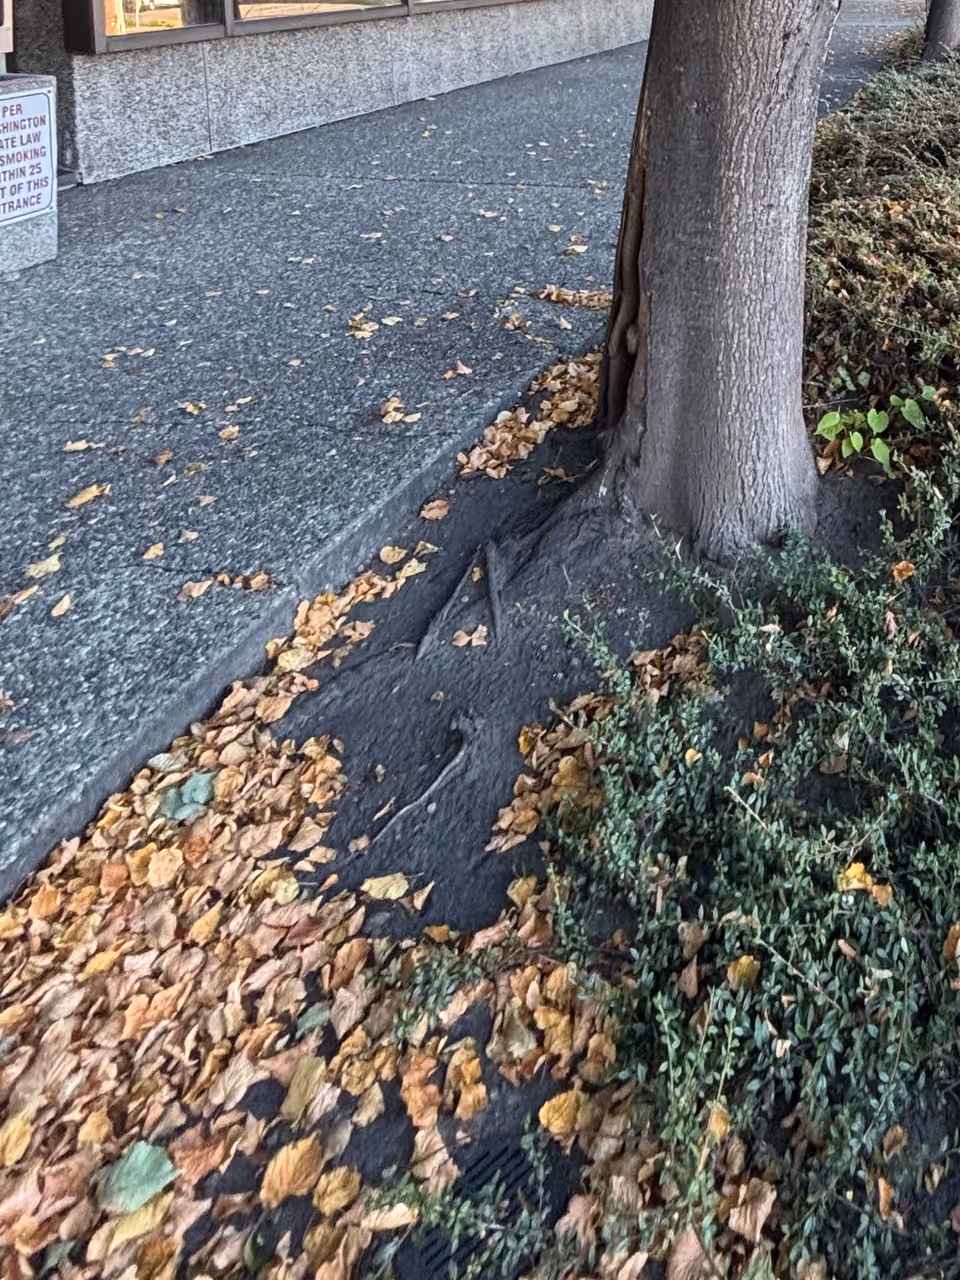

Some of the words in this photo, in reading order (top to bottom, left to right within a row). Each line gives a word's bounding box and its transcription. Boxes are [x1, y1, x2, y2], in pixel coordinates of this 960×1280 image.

[2, 104, 23, 118] PER
[0, 114, 46, 134] HINGTON
[20, 130, 41, 146] LAW
[0, 145, 46, 167] SMOKING
[0, 166, 26, 183] THIN
[29, 162, 42, 176] 25
[10, 182, 24, 196] OF
[26, 176, 49, 192] THIS
[0, 193, 42, 214] TRANCE
